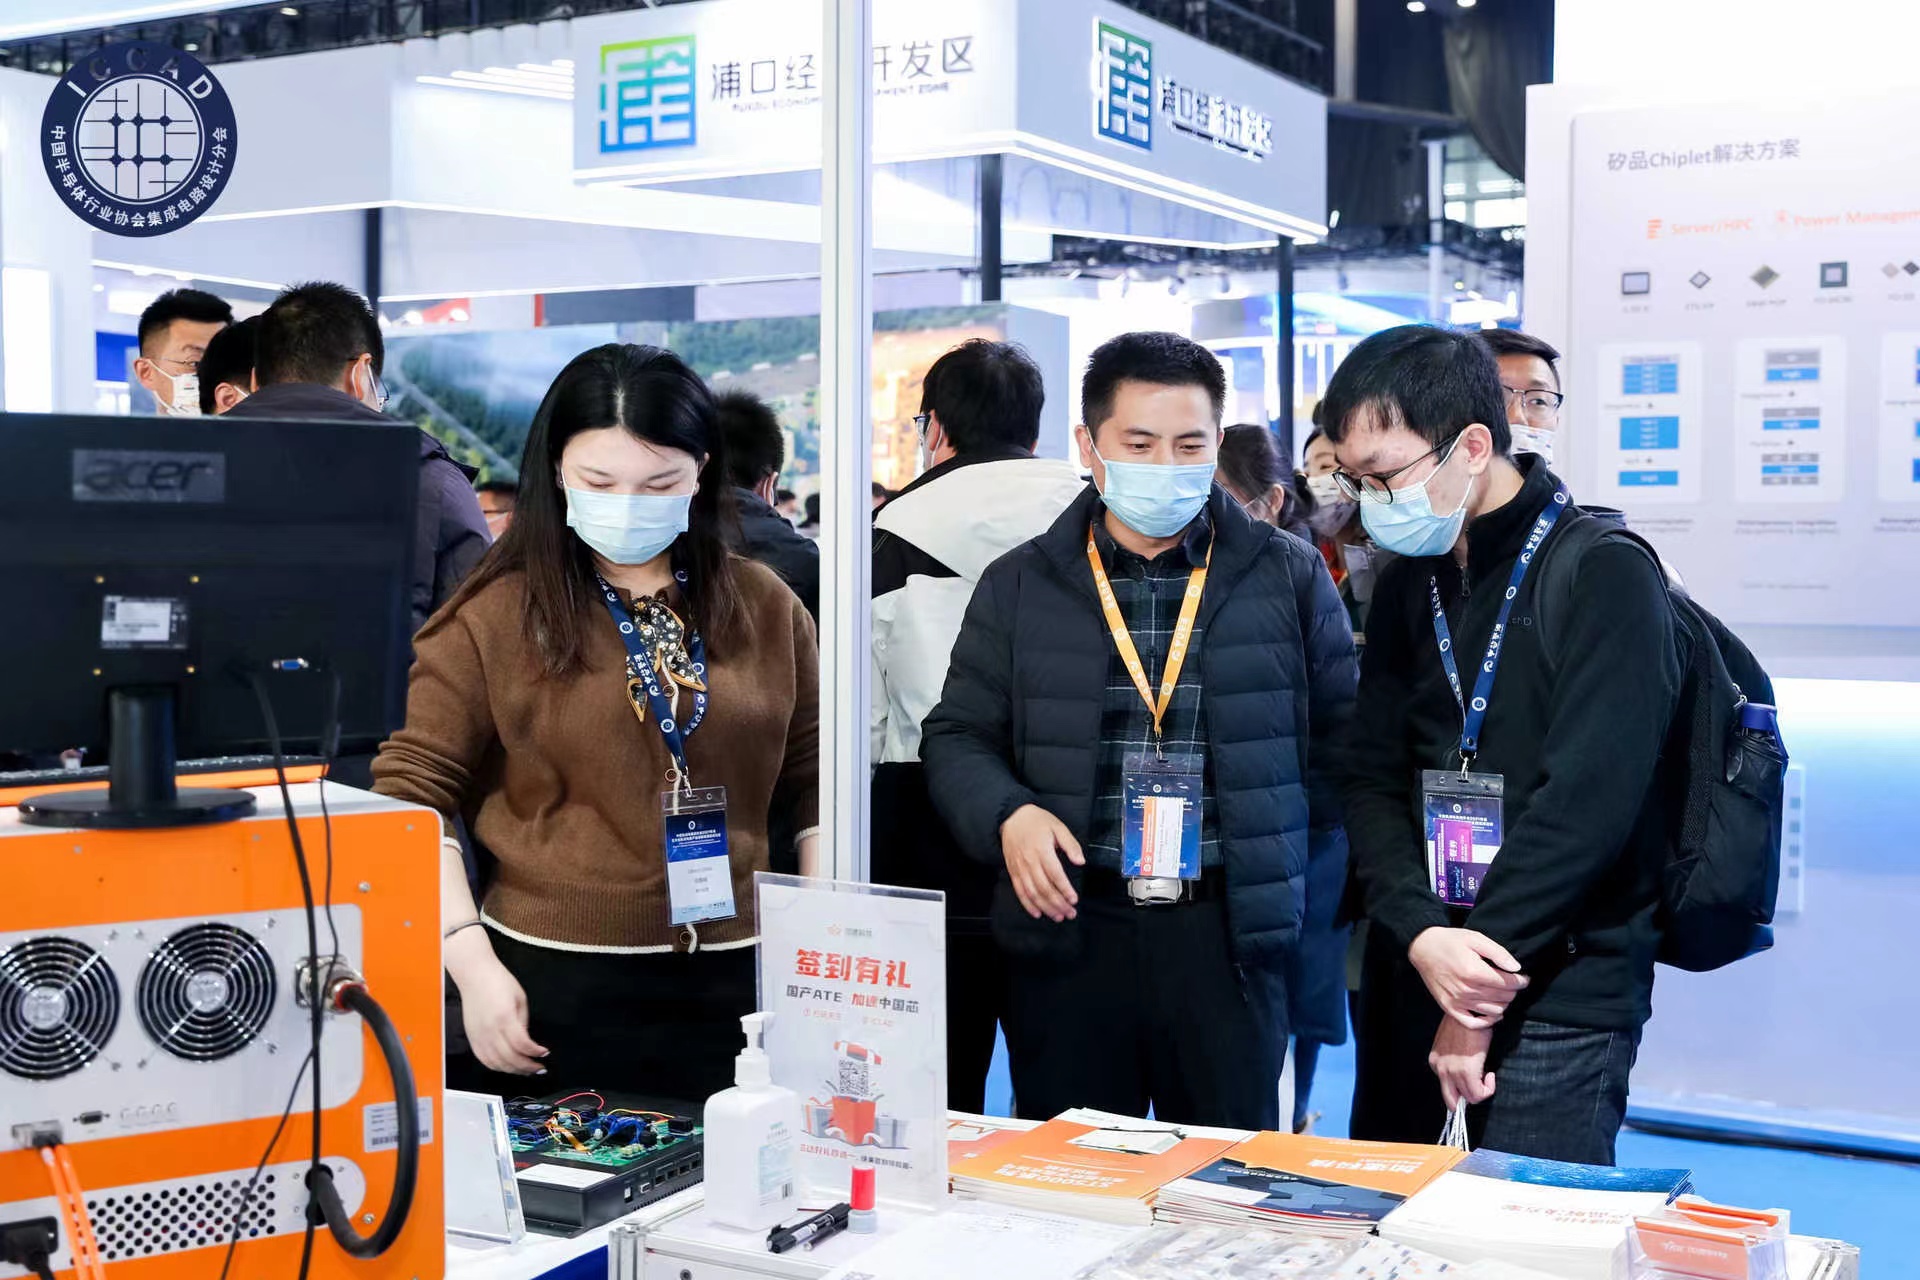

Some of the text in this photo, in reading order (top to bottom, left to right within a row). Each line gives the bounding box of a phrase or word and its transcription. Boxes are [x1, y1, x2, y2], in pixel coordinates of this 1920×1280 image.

[83, 458, 212, 495] acer
[795, 947, 912, 989] 签到有礼
[786, 984, 843, 1003] 国产ATE
